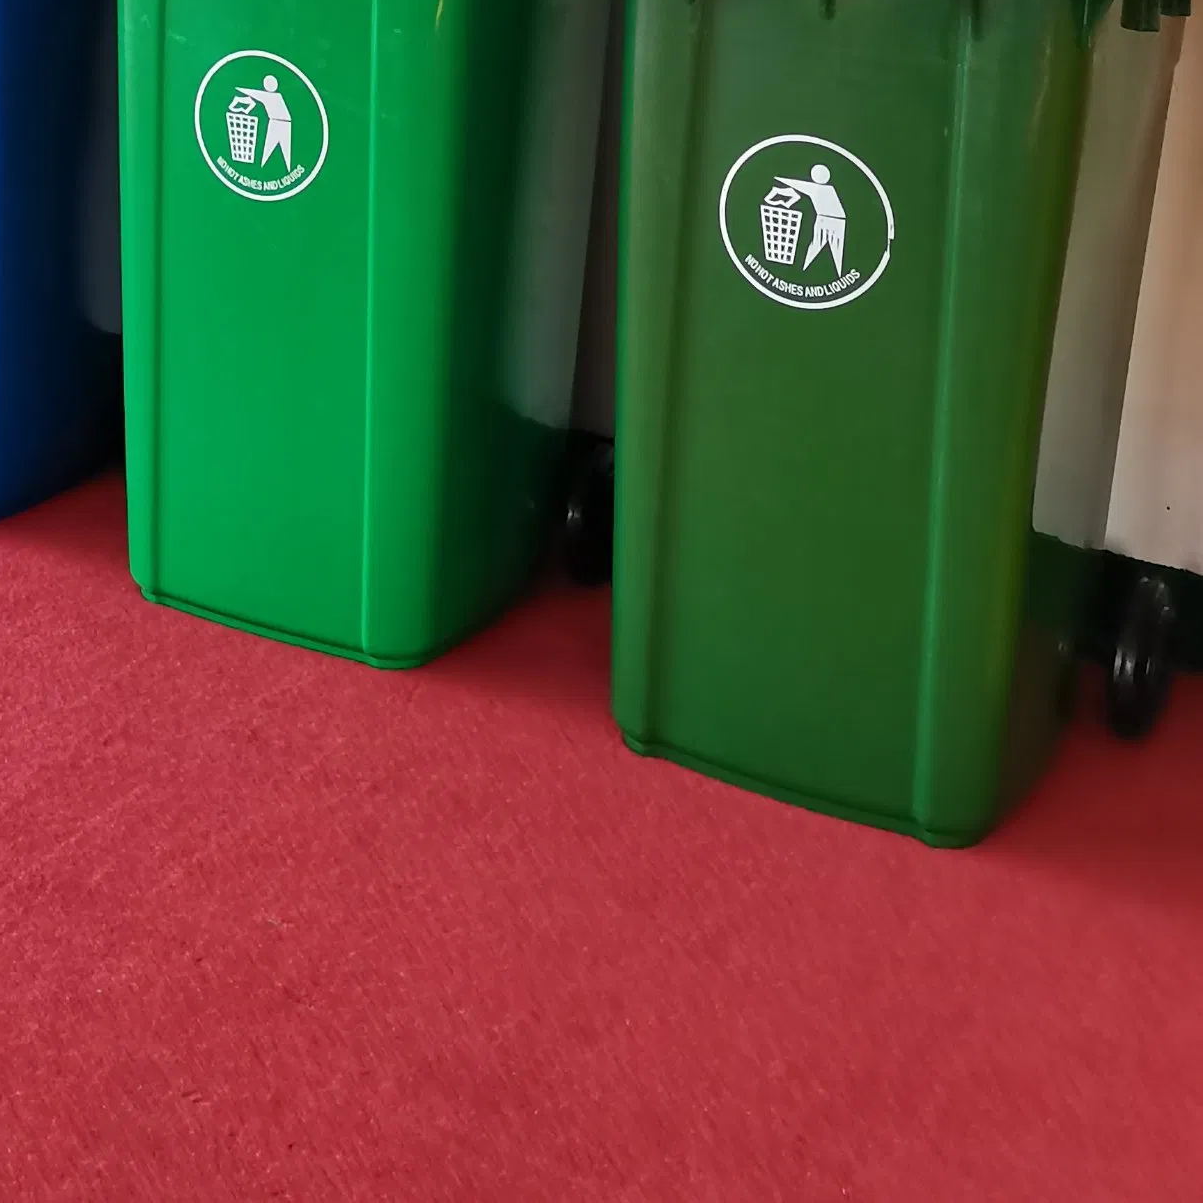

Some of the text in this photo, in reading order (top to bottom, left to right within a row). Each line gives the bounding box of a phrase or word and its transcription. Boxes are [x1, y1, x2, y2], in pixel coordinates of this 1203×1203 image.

[772, 278, 803, 296] ASHES
[805, 286, 824, 297] AND
[823, 268, 860, 296] LIQUIDS
